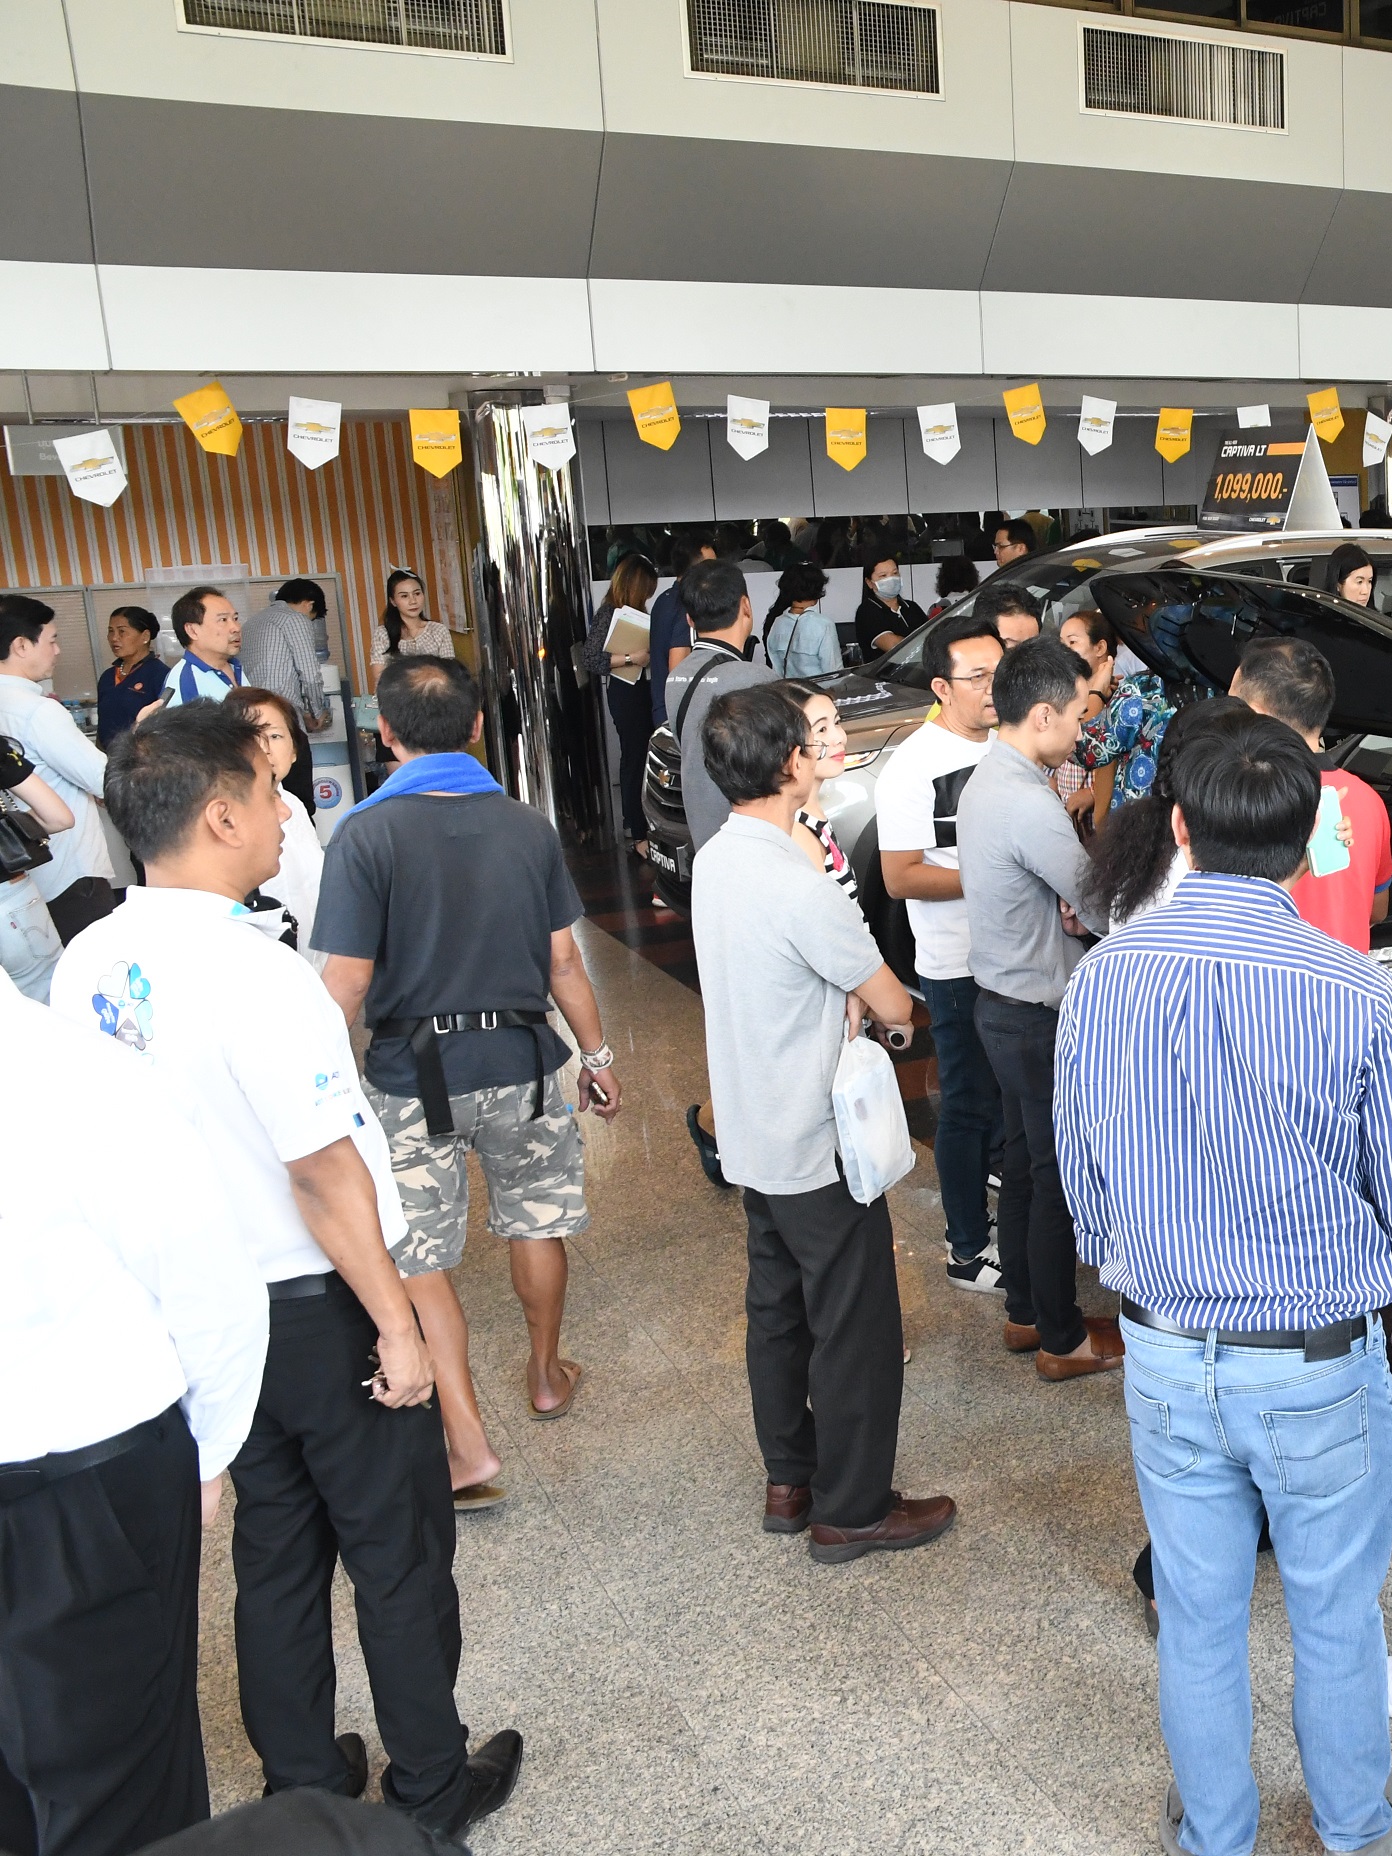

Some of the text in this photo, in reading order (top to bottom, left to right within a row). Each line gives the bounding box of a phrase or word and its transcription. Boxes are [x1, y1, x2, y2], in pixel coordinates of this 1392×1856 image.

[641, 416, 675, 429] CHEVROLET
[1014, 414, 1042, 426] CHEVROLET
[200, 417, 235, 439] CHEVROLET
[730, 428, 764, 437] CHEVROLET
[1081, 426, 1109, 435] CHEVROLET
[292, 433, 334, 443] CHEVROLET
[532, 438, 569, 448] CHEVROLET
[925, 434, 956, 443] CHEVROLET
[1220, 444, 1267, 458] CAPTIVA LT
[74, 468, 118, 483] CHEVROLET
[1213, 472, 1288, 503] 1,099,000.-
[319, 785, 333, 799] 5
